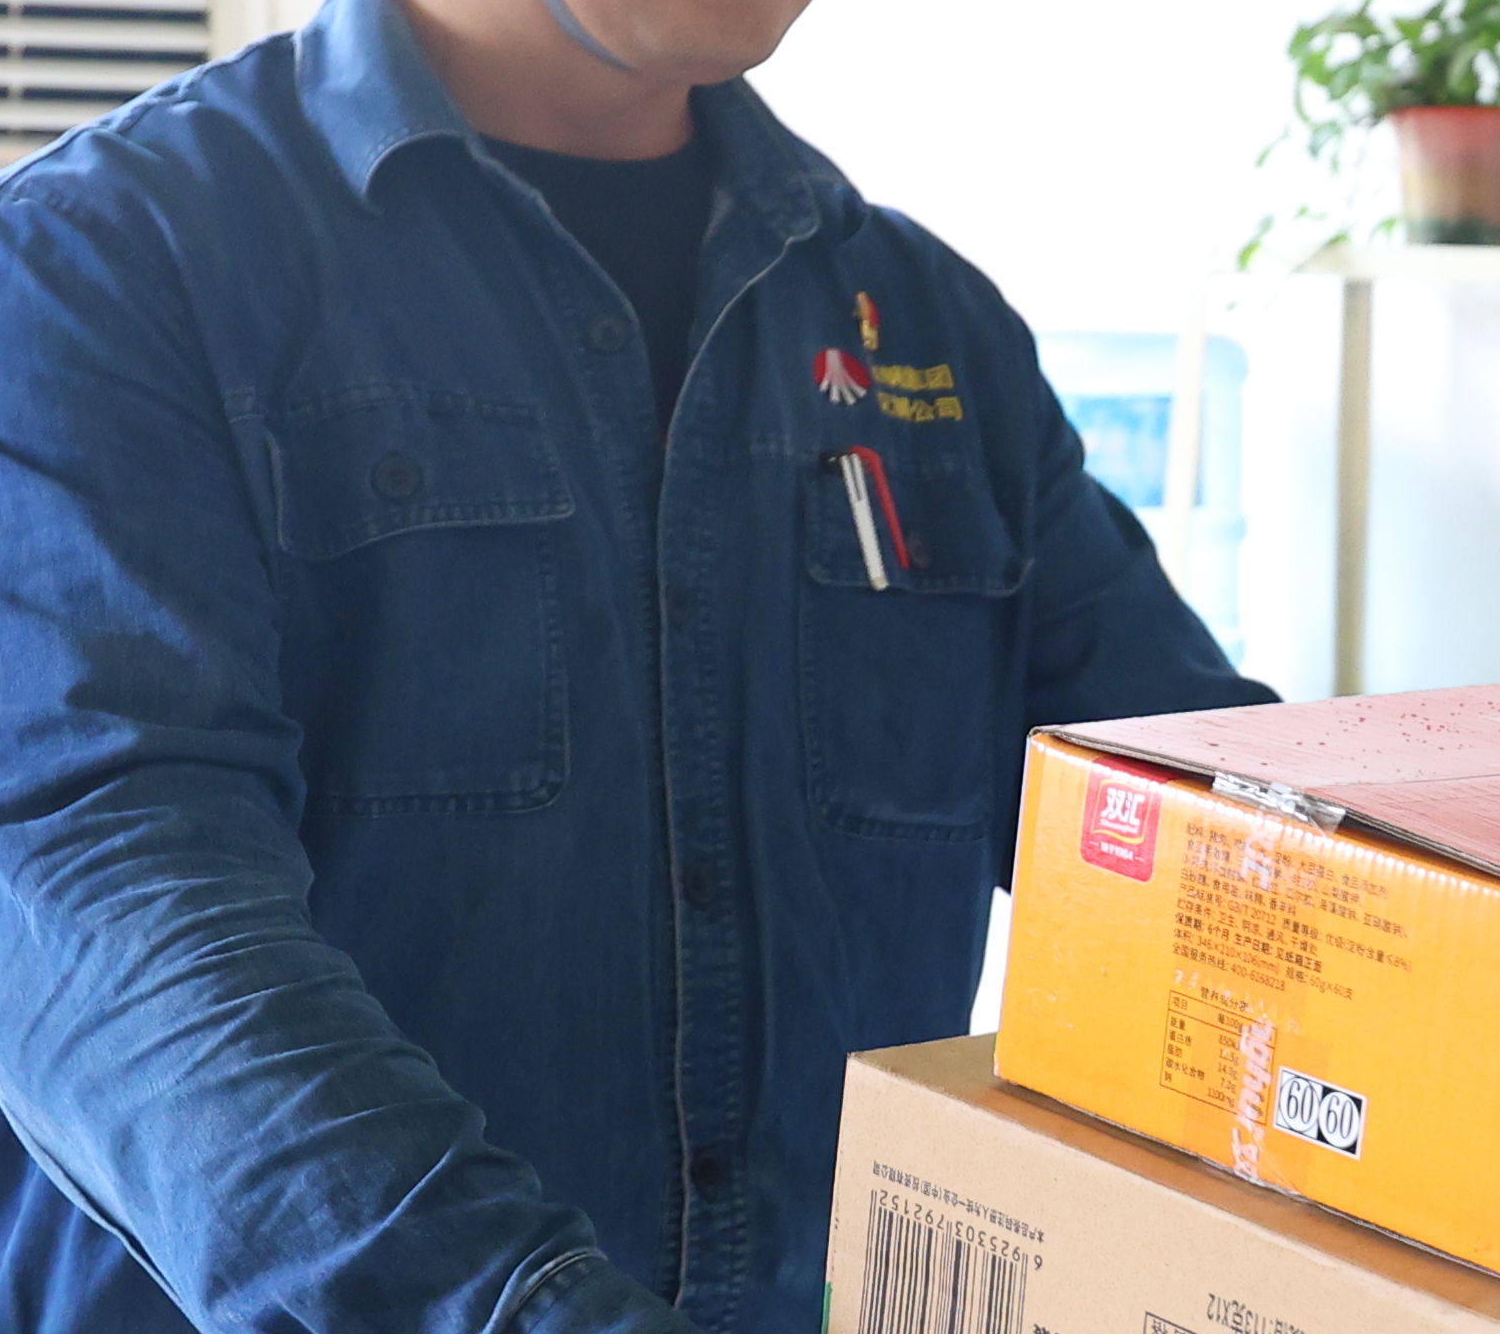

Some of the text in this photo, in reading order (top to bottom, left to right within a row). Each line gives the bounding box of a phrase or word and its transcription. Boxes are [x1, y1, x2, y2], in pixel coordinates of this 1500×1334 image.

[1100, 787, 1145, 825] 双汇
[1286, 1079, 1354, 1140] 60 60
[880, 1189, 1044, 1271] 6 925303 792152
